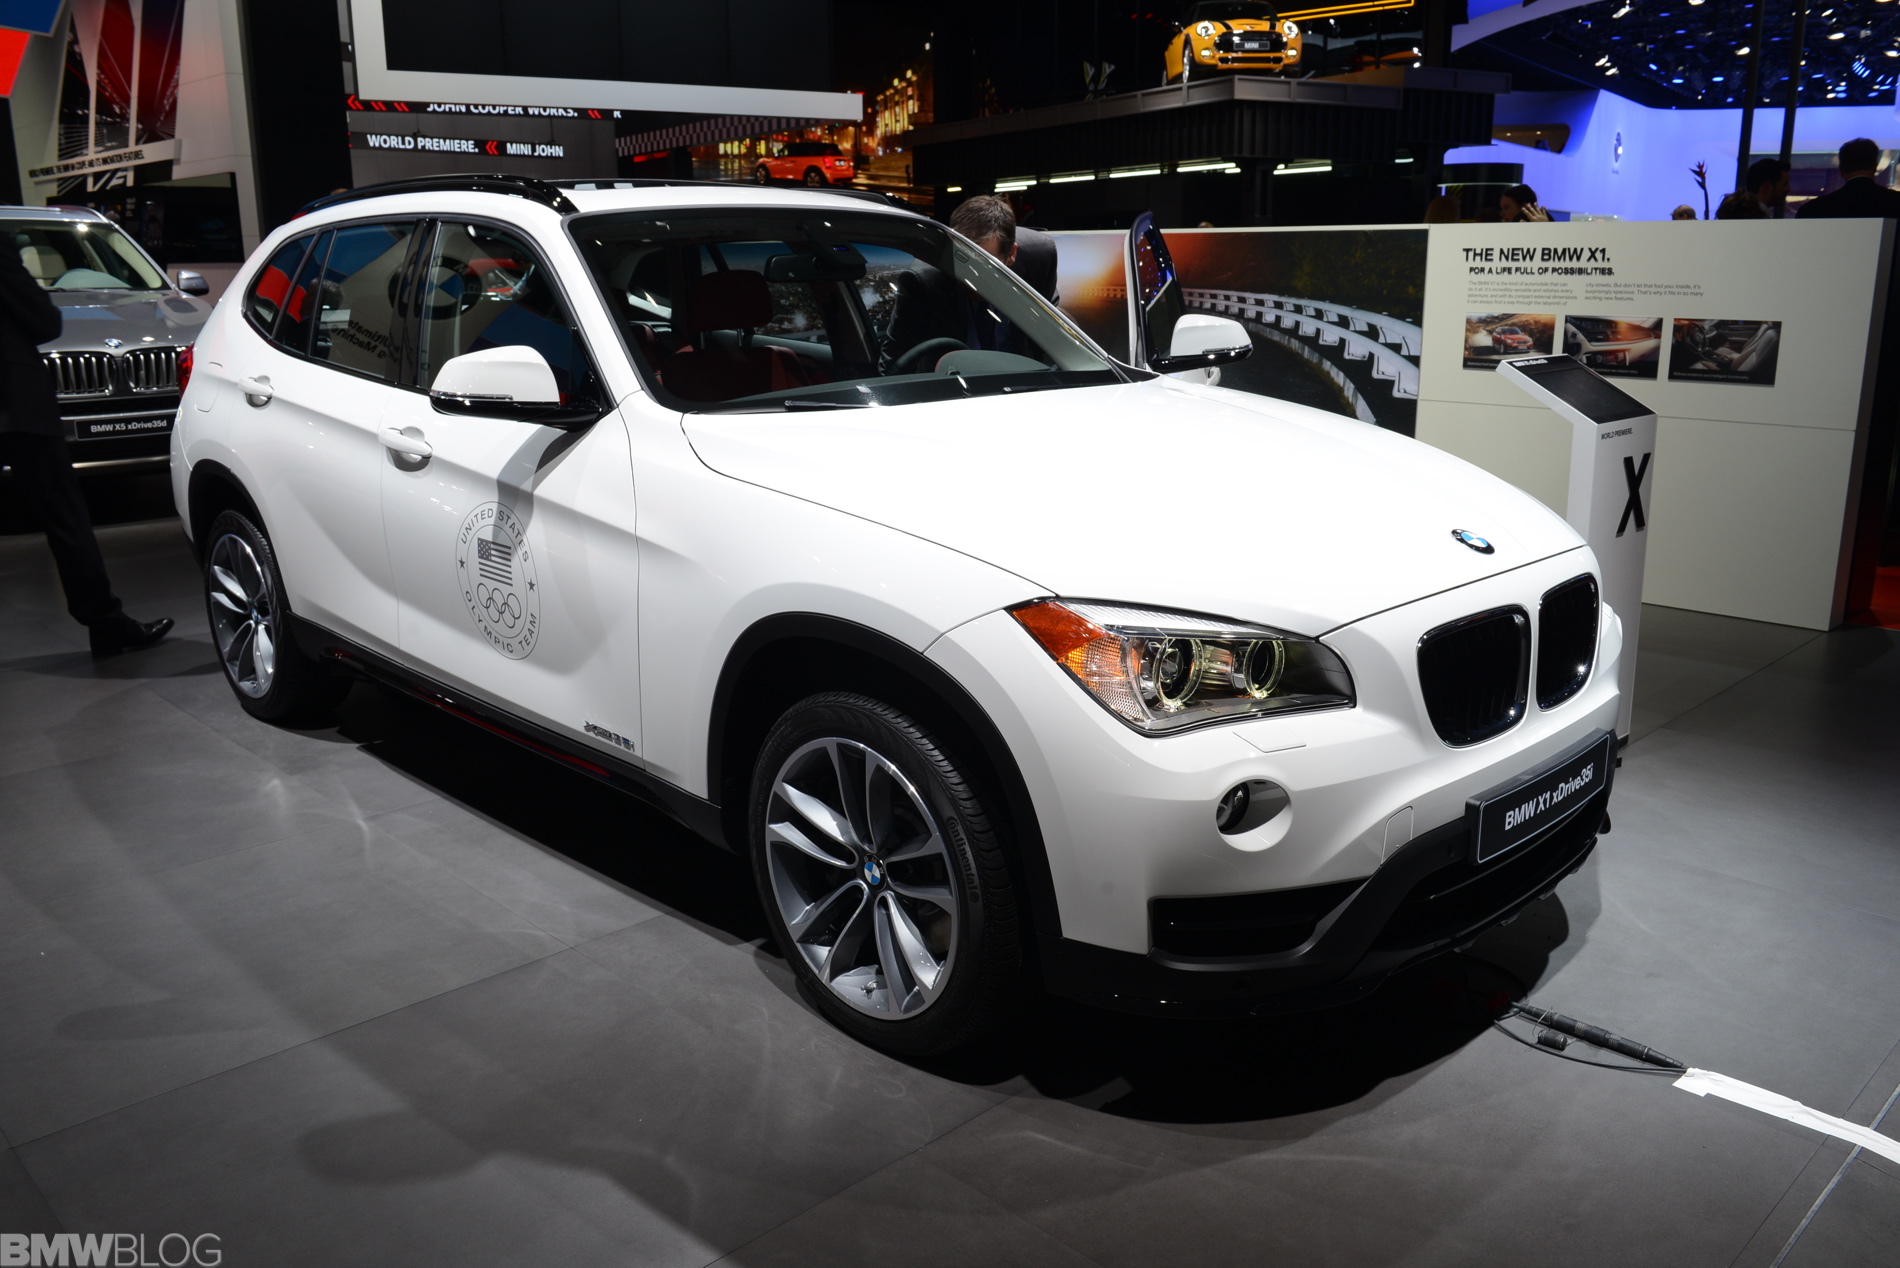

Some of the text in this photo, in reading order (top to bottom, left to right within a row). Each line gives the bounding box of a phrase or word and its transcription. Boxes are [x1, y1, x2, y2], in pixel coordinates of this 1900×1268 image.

[367, 134, 564, 157] WORLD PREMIERE. MINI JOHN
[1463, 247, 1611, 262] THE NEW BMW X1.
[1469, 267, 1615, 276] FOR A LIFE FULL OF POSSIBILITIES.
[90, 420, 167, 433] BMW X5 xDrive35d
[1615, 452, 1651, 538] X
[461, 508, 529, 563] UNITED STATES
[465, 590, 537, 654] OLYMPIC TEAM
[1504, 762, 1594, 831] BMW X1 xDrive35i
